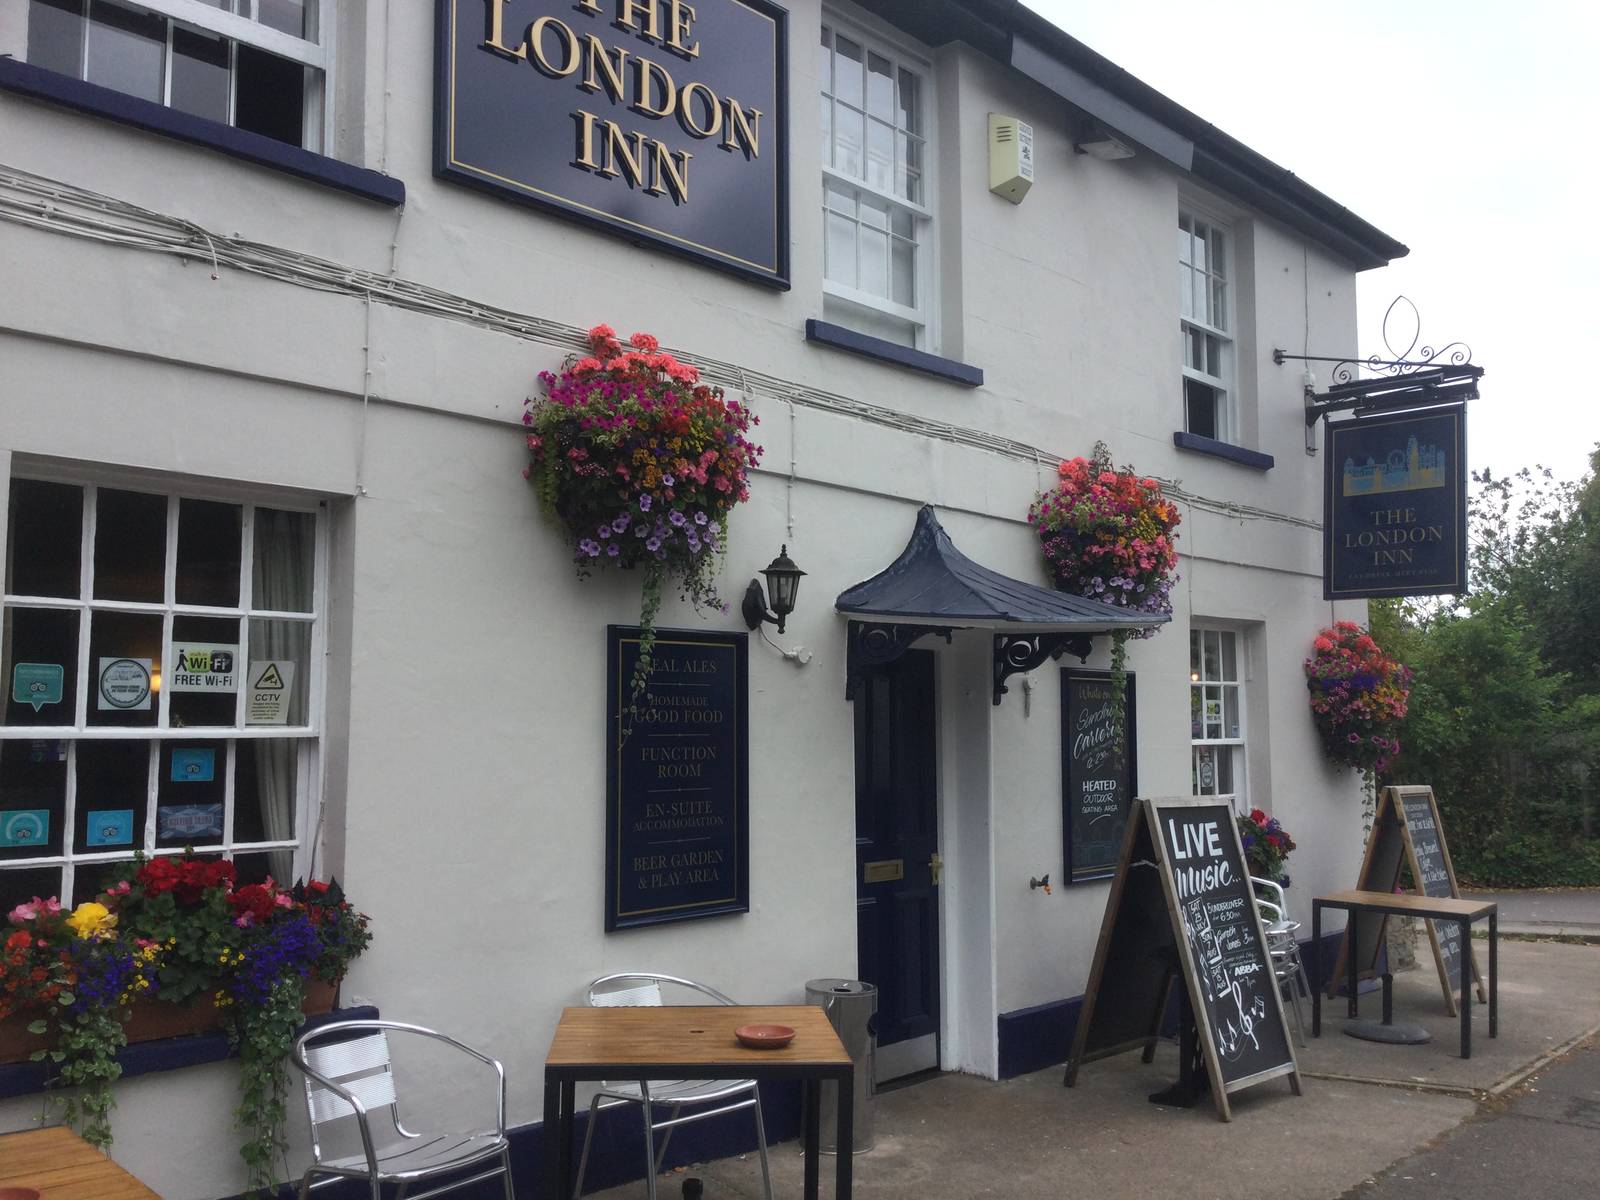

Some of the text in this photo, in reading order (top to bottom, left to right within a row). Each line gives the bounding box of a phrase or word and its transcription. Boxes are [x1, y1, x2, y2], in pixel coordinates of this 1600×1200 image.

[574, 0, 699, 58] HE
[482, 0, 763, 159] LONDON
[574, 110, 693, 204] INN
[1370, 507, 1416, 526] THE
[1345, 525, 1442, 548] LONDON
[1373, 548, 1413, 566] INN
[650, 658, 718, 673] EAL ALES
[175, 674, 232, 687] FREE Wi-Fi
[255, 693, 280, 702] CCTV
[651, 695, 709, 707] HOMEMADE
[634, 709, 723, 723] GOOD FOOD
[641, 746, 716, 761] FUNCTION
[658, 763, 701, 778] ROOM
[1082, 780, 1117, 792] HEATED
[1083, 792, 1114, 804] OUTDOOR
[1104, 804, 1118, 812] AREA
[633, 815, 724, 832] ACCOMMODATION
[1169, 818, 1223, 859] LIVE
[634, 849, 723, 871] BEER GARDEN
[638, 868, 719, 889] & PLAY AREA
[1190, 899, 1201, 914] SAT
[1234, 963, 1260, 976] ABBA
